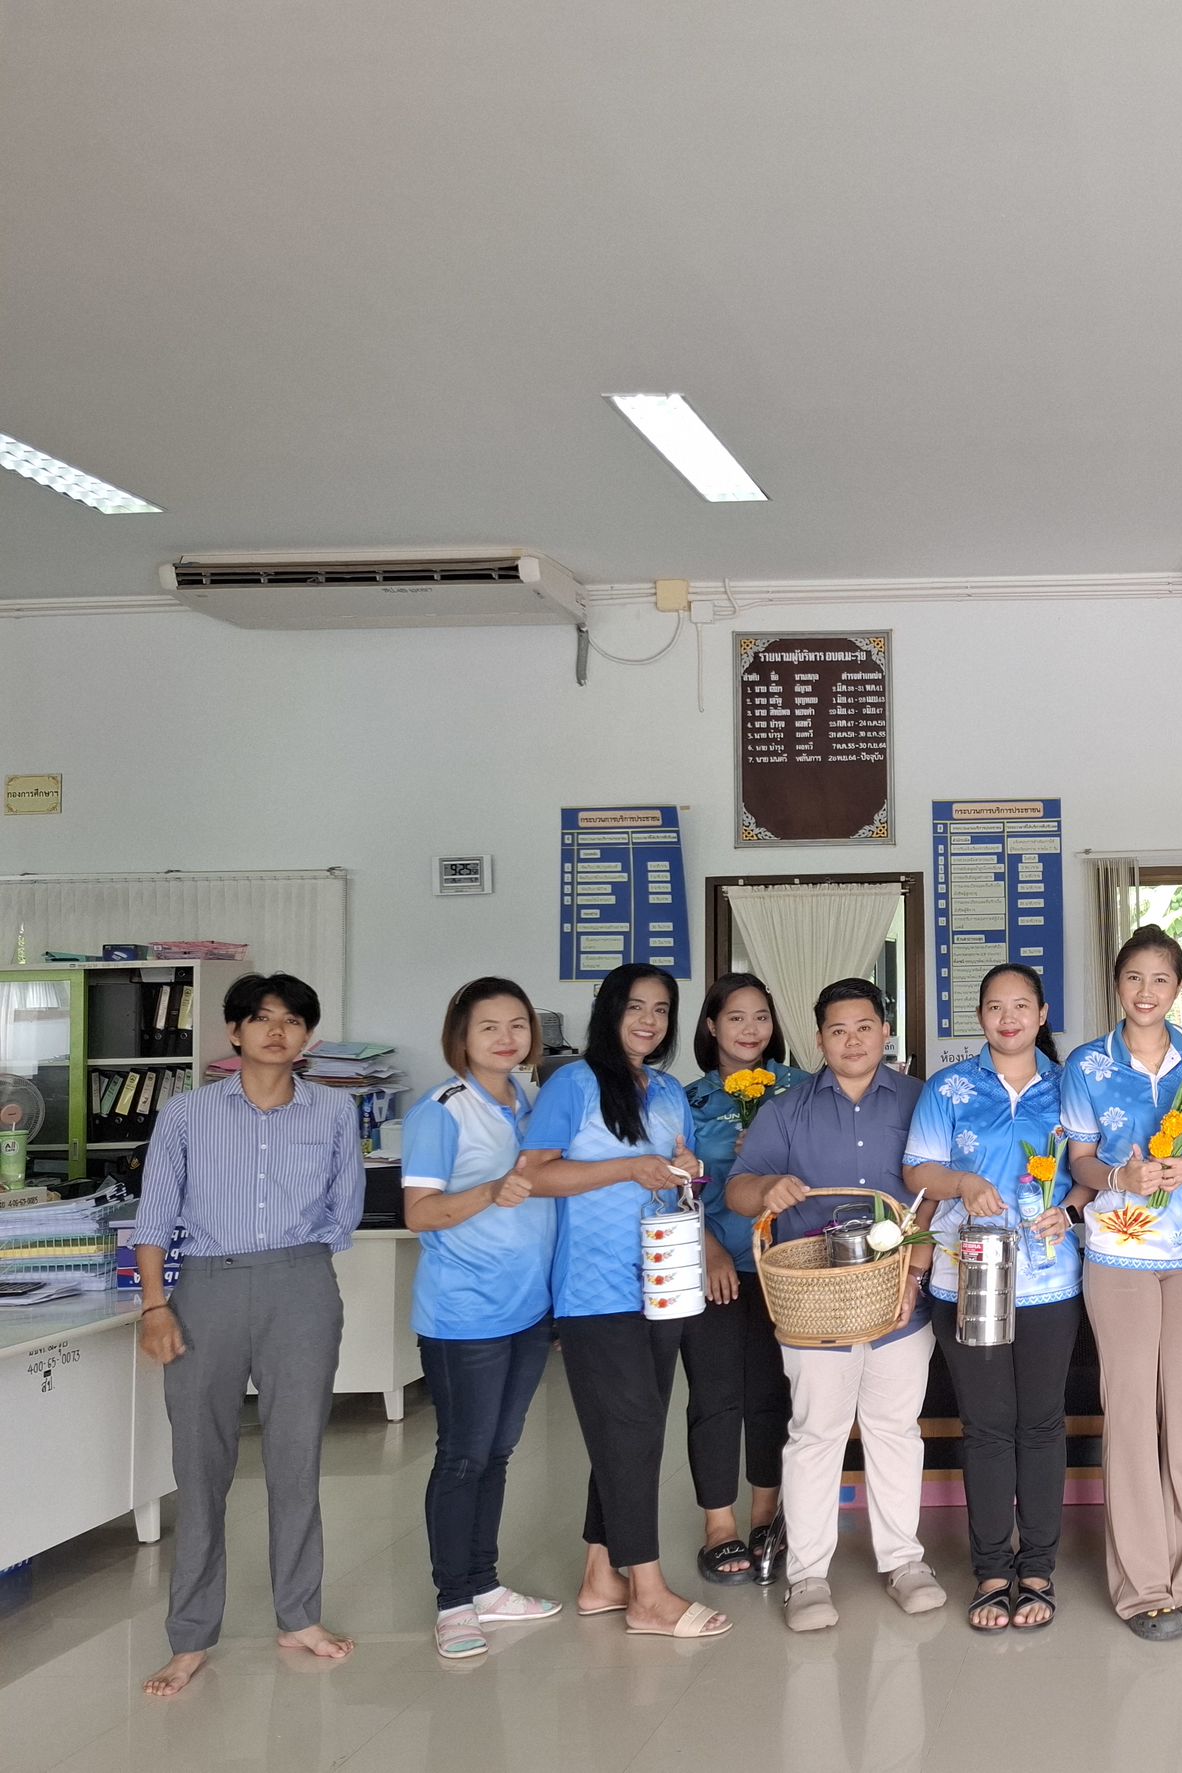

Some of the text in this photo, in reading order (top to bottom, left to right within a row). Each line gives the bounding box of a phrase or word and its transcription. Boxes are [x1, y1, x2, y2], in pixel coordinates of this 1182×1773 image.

[758, 650, 824, 664] รายนามผู้บริหาร
[7, 788, 59, 798] กองการศึกษาฯ
[954, 805, 1040, 816] กระบวนการบริการประชาชน
